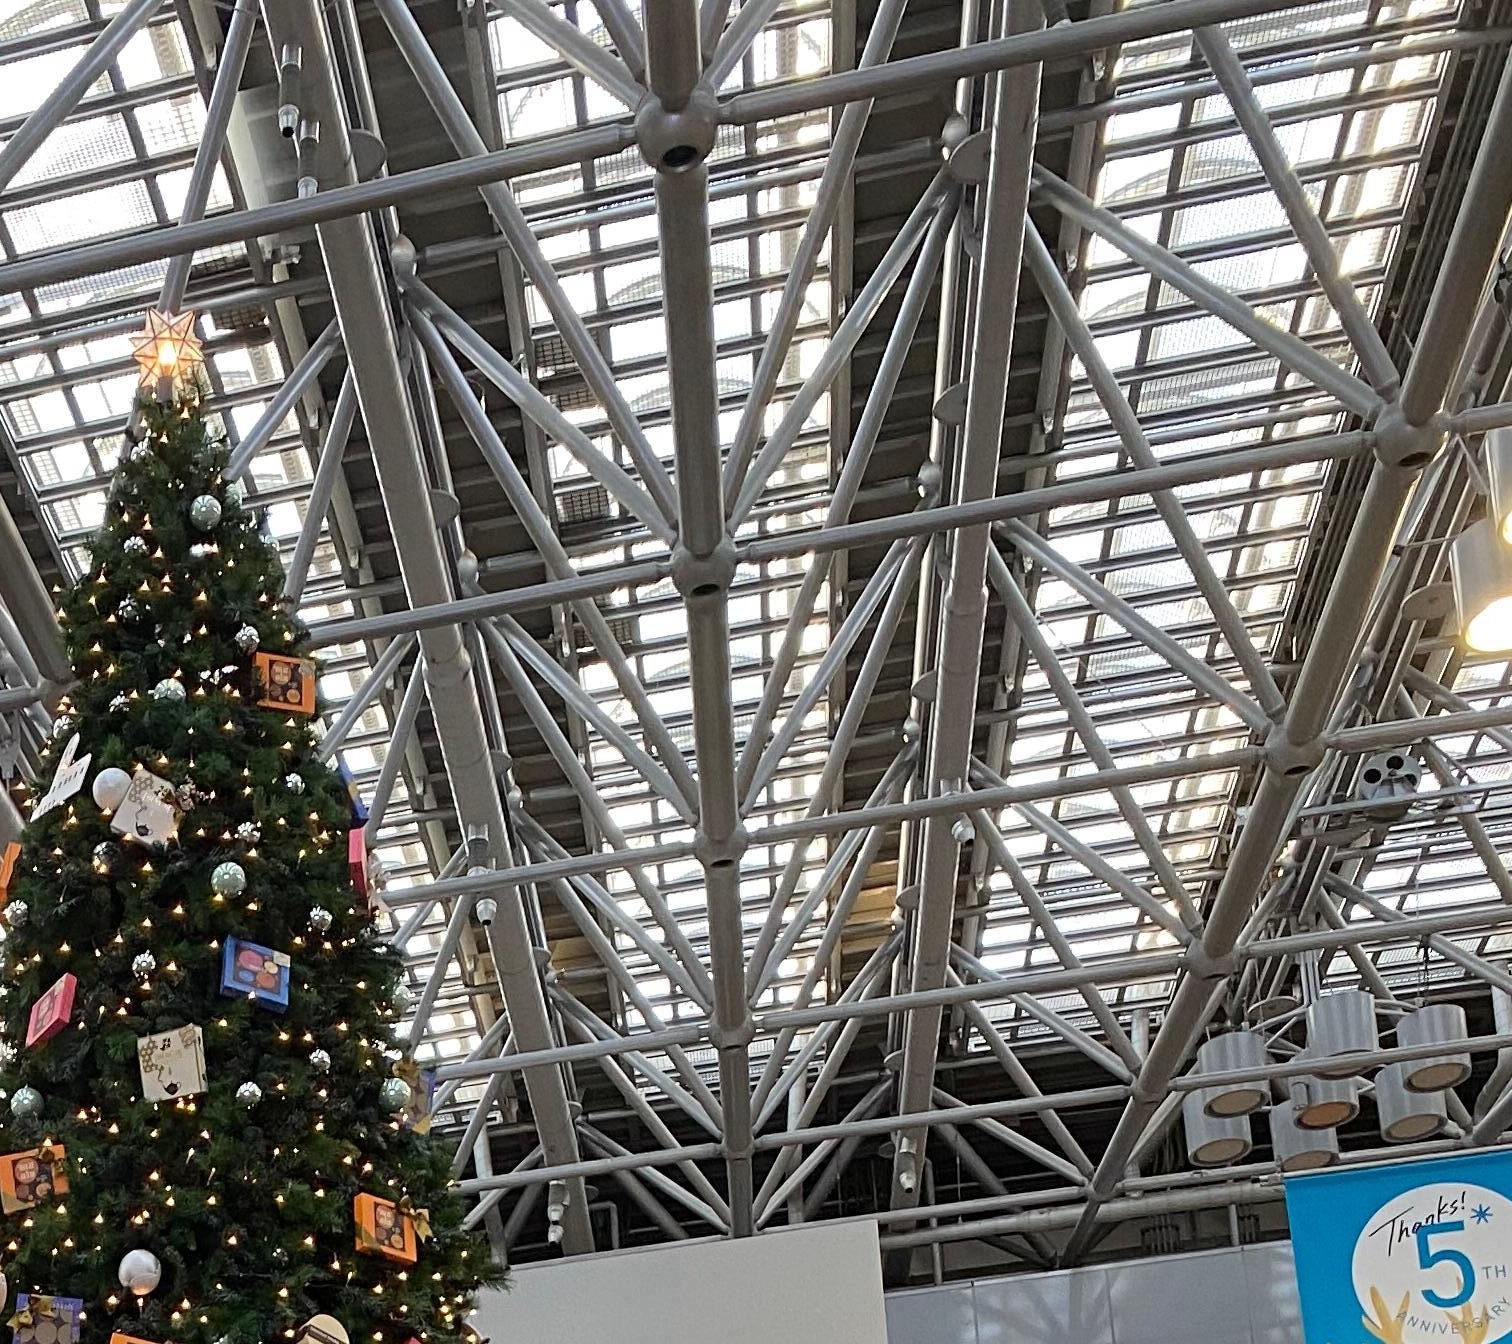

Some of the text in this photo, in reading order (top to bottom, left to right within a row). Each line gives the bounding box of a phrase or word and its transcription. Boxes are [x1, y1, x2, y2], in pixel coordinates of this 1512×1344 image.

[1368, 1191, 1467, 1257] Thanks!
[1416, 1220, 1507, 1308] 5 TH
[1395, 1296, 1510, 1336] ANNIVERSARY
